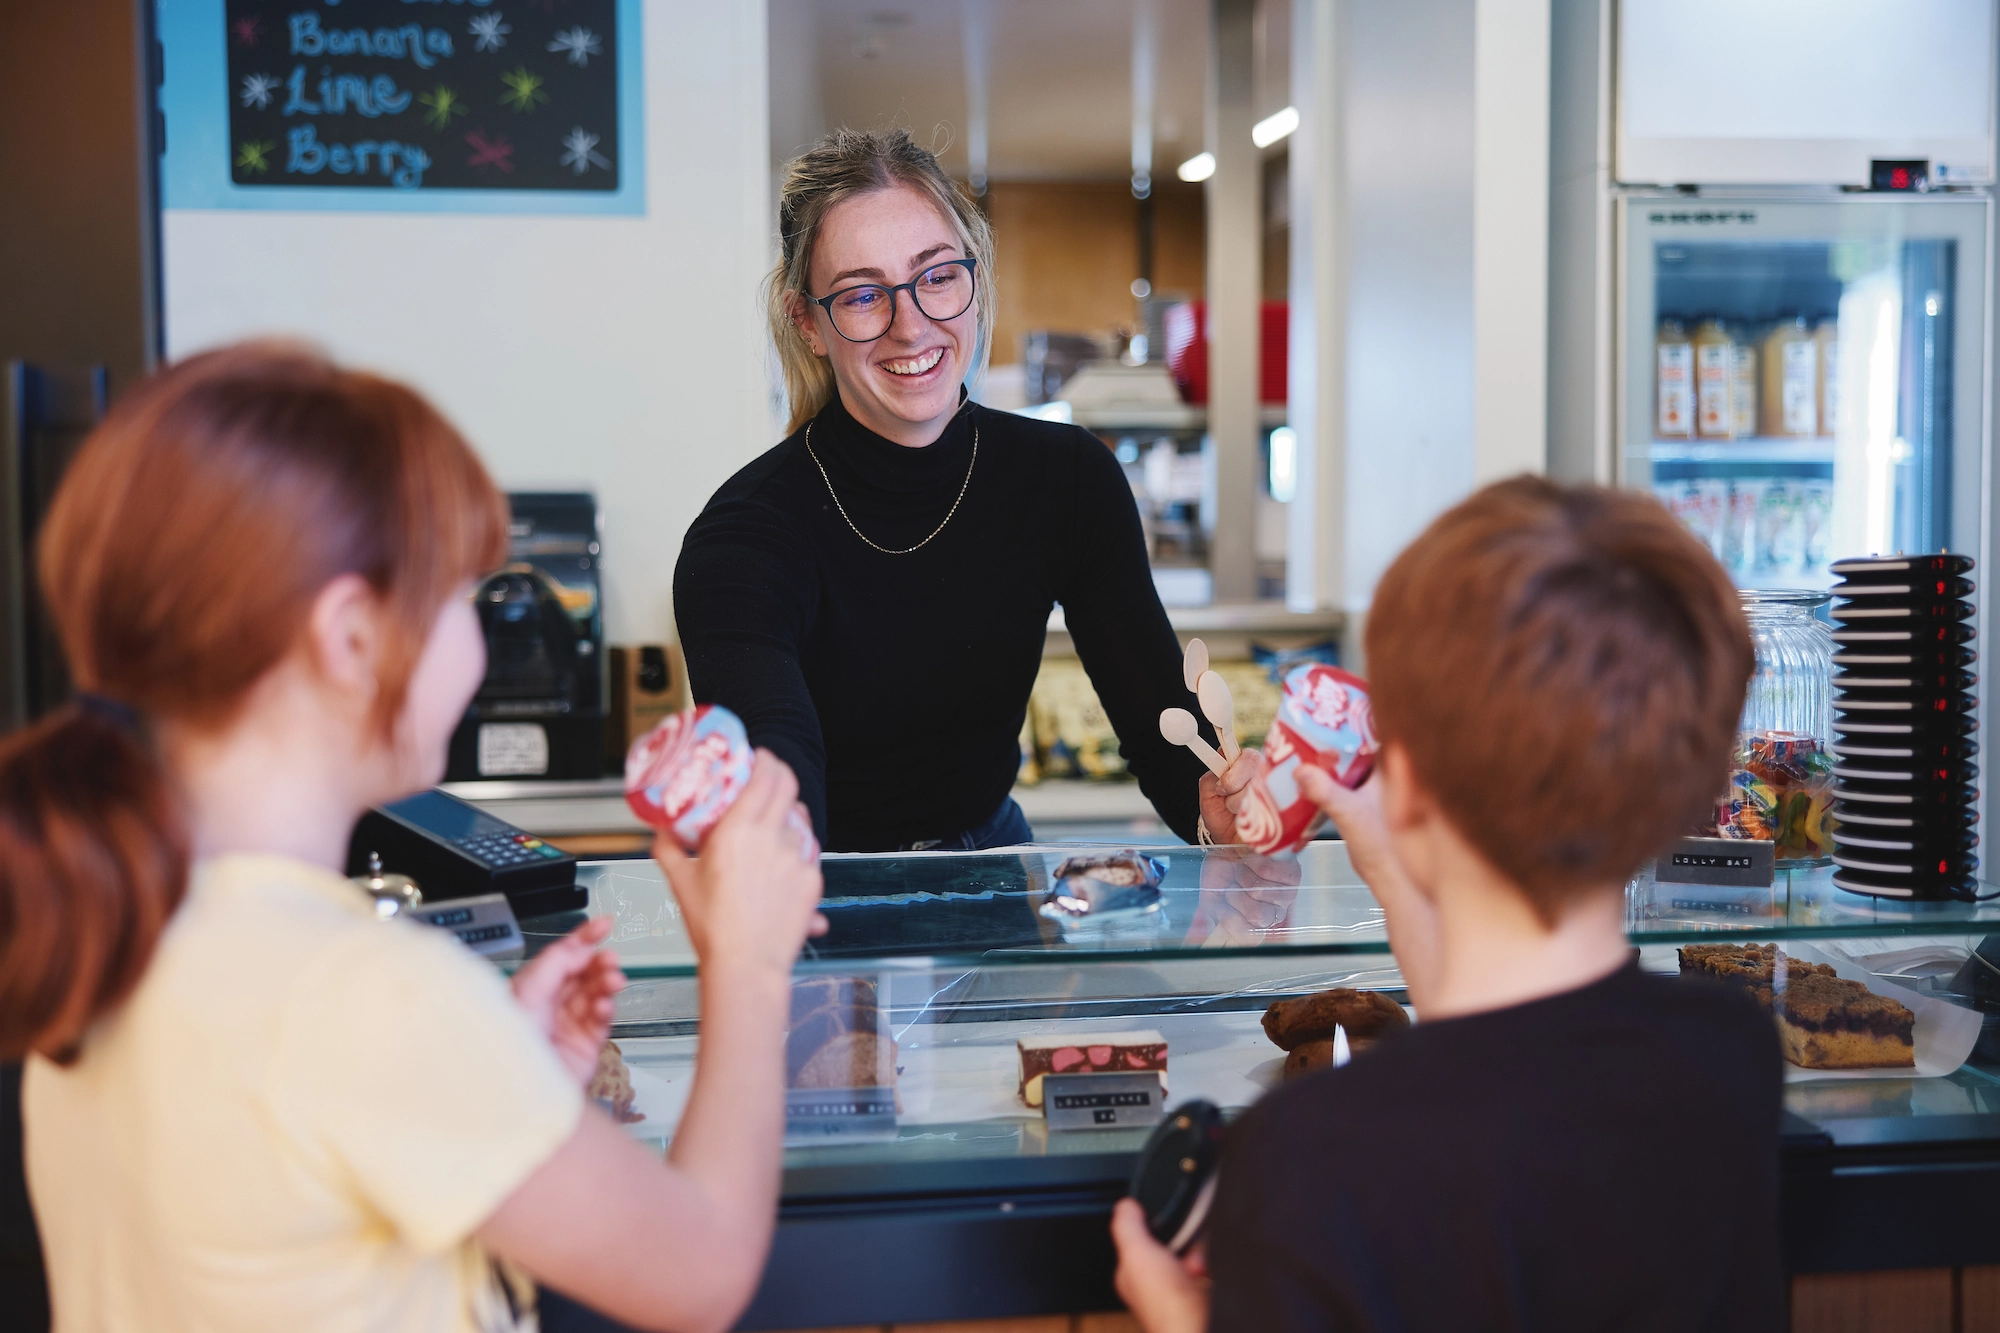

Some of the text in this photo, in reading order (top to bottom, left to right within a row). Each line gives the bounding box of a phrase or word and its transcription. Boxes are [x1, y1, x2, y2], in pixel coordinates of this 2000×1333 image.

[287, 11, 454, 68] Banana
[282, 65, 412, 117] Lime
[285, 123, 432, 190] Berry
[1675, 857, 1749, 866] LOLLY BAG
